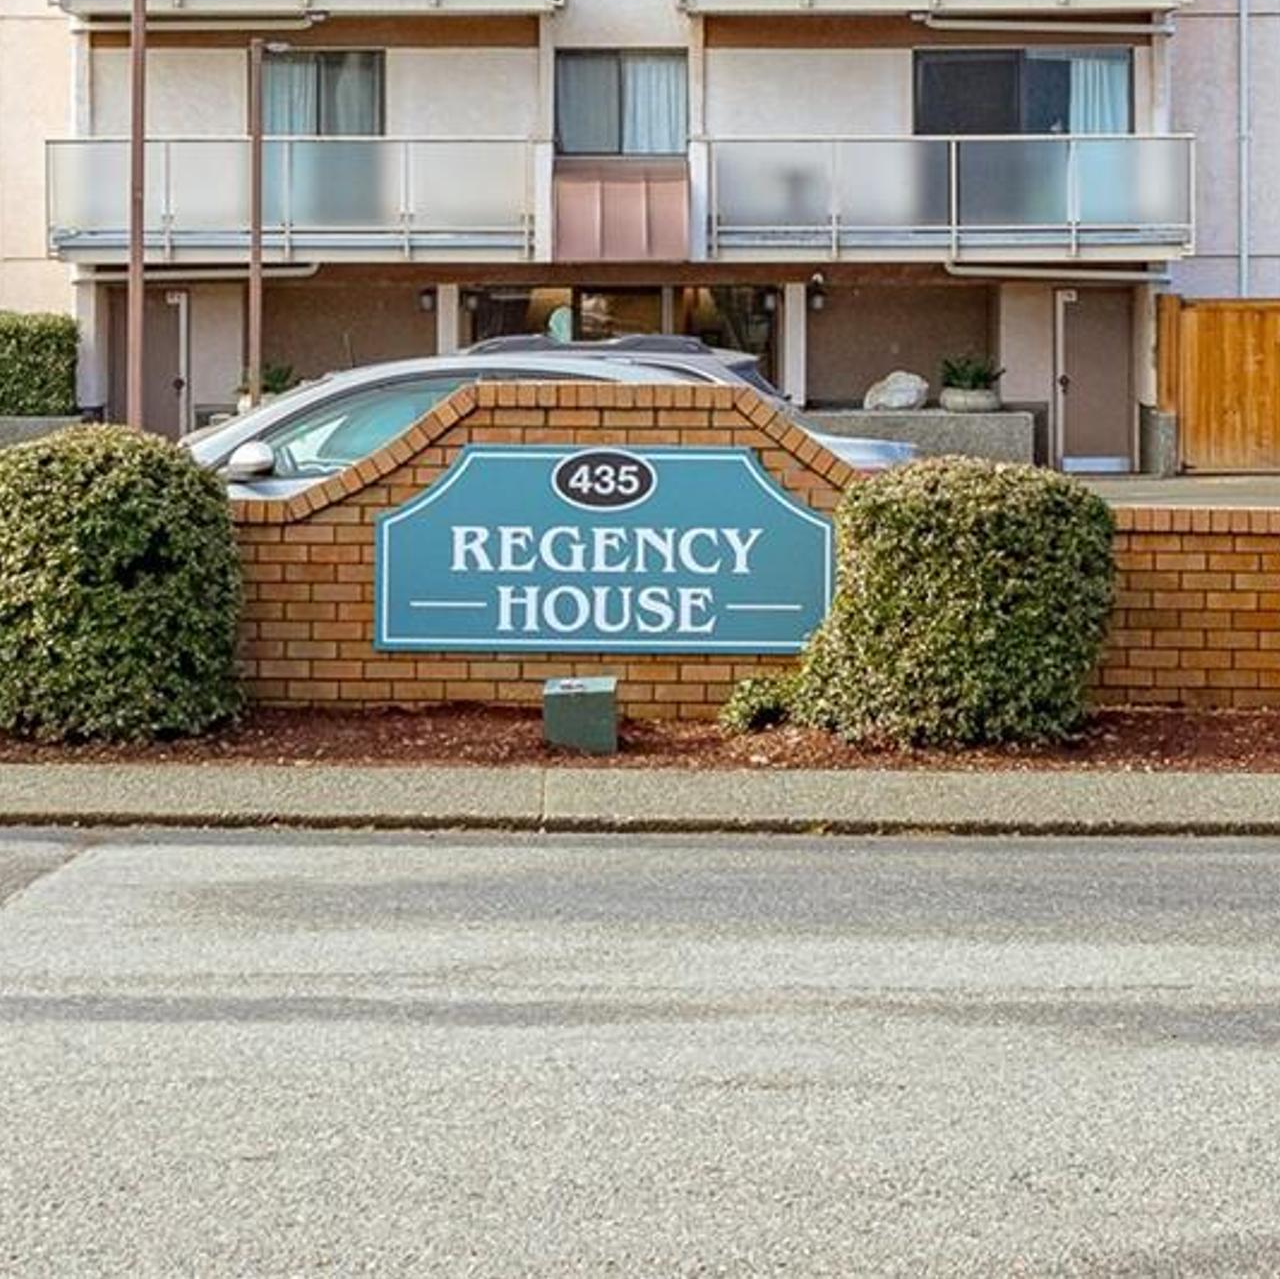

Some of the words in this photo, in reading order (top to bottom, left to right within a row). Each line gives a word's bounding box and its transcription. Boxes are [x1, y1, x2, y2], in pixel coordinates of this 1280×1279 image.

[568, 464, 640, 495] 435
[450, 525, 763, 574] REGENCY
[496, 585, 717, 634] HOUSE
